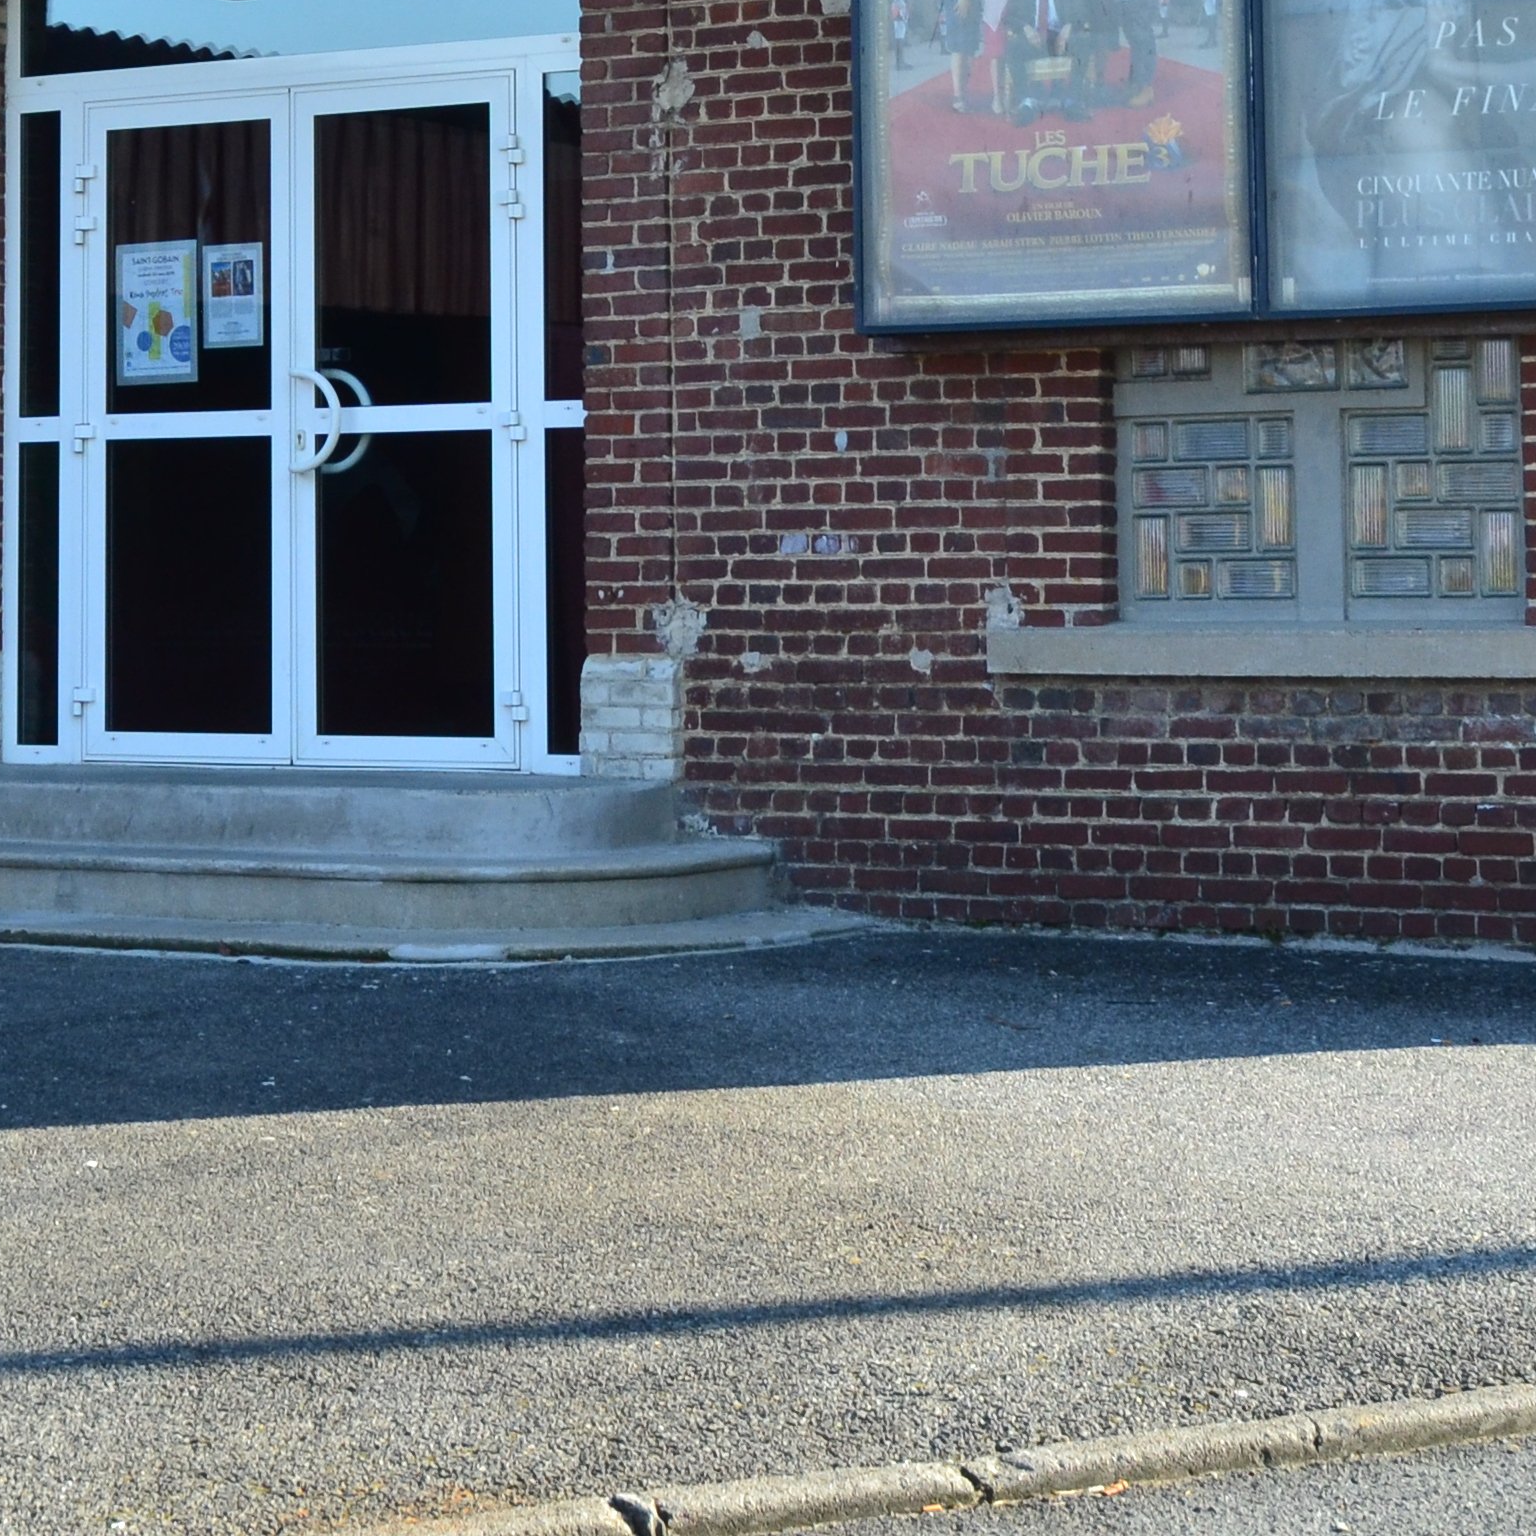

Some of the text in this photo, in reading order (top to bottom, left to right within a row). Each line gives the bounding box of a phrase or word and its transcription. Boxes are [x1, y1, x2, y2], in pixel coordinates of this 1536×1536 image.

[1432, 16, 1520, 50] PAS
[1375, 88, 1426, 121] LE
[1035, 129, 1067, 149] LES
[949, 142, 1172, 194] TUCHE 3
[1357, 170, 1493, 198] CINQUANTE
[1006, 207, 1103, 224] OLIVIER BAROUX
[1357, 196, 1445, 229] PLUS
[1359, 233, 1473, 250] L'ULTIME
